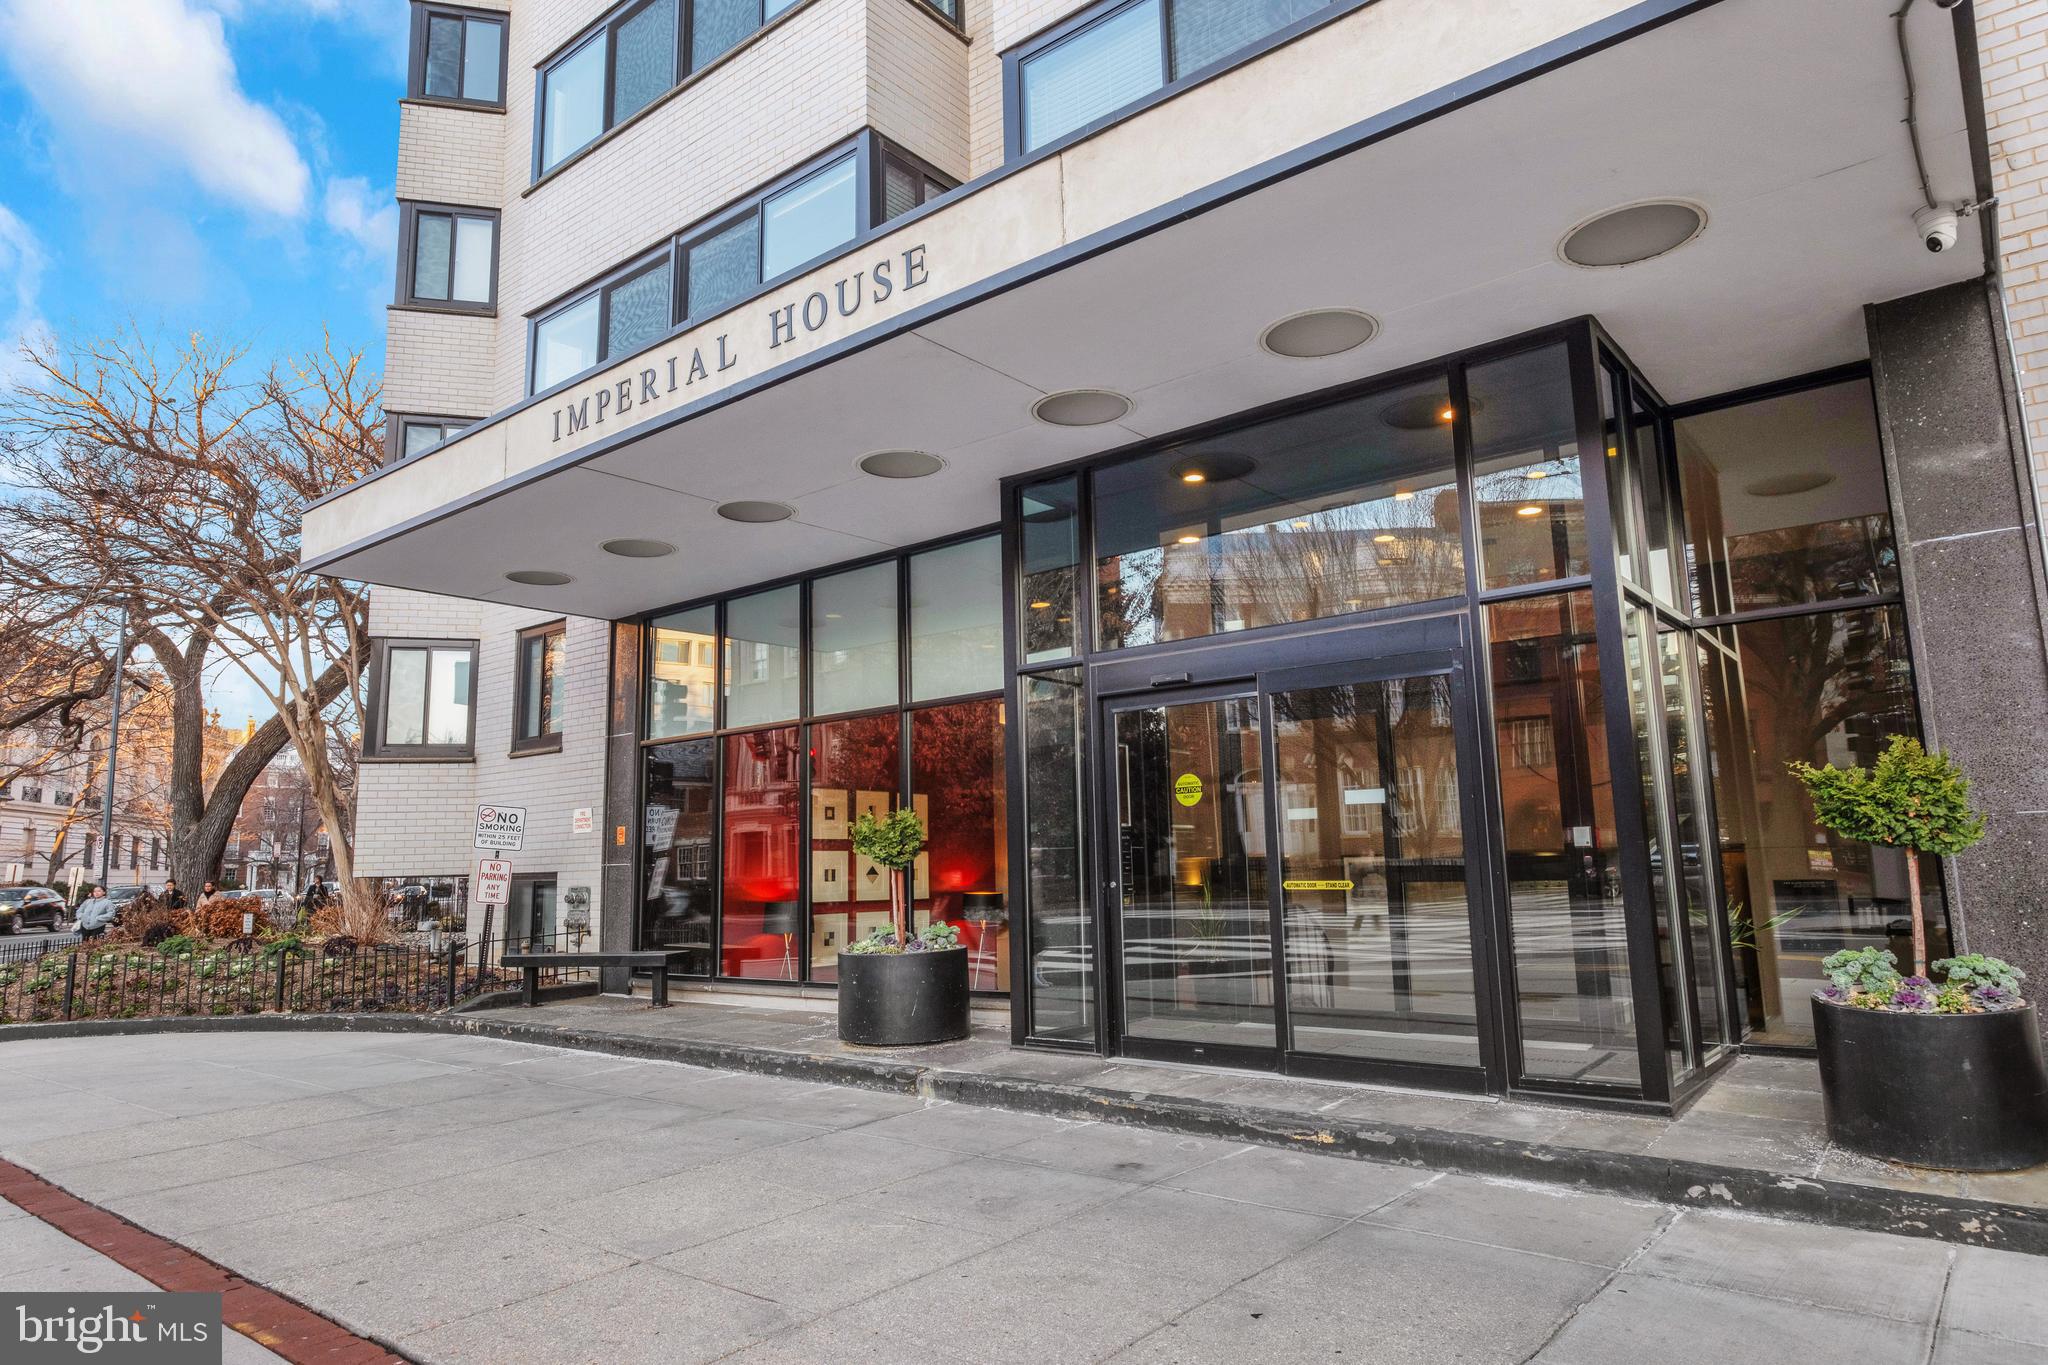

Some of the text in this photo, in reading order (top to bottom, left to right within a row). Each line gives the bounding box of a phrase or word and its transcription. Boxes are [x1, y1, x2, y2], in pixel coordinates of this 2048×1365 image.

[552, 243, 929, 442] IMPERIAL HOUSE
[1176, 786, 1201, 794] CAUTION
[497, 813, 518, 824] NO
[479, 823, 522, 832] SMOKING
[490, 863, 502, 871] NO
[481, 872, 508, 882] PARKING
[486, 883, 501, 891] ANY
